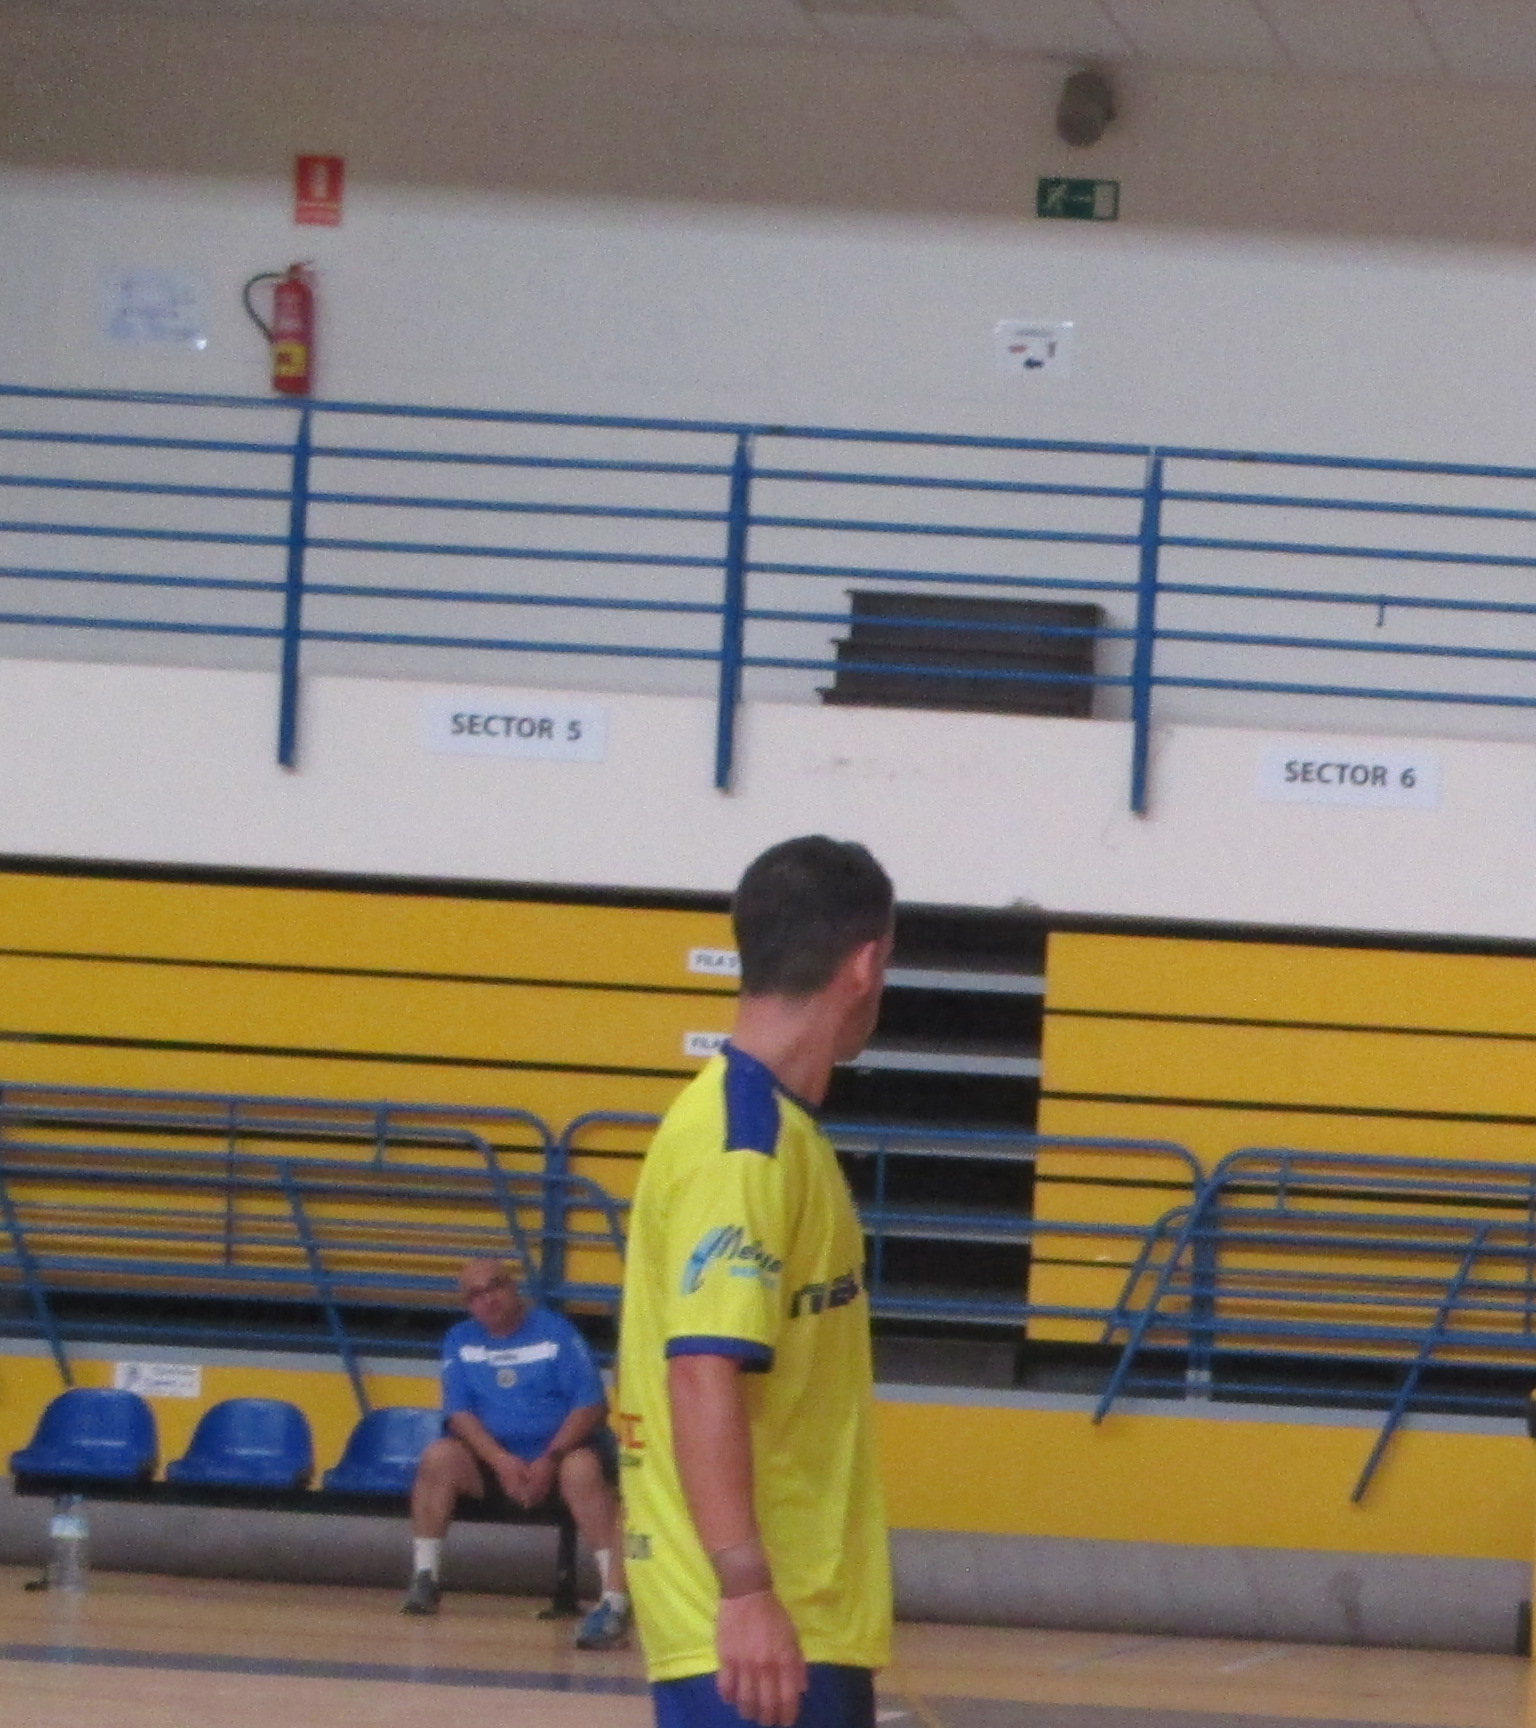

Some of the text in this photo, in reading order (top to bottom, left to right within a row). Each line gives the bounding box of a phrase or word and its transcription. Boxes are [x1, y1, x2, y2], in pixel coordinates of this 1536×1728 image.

[451, 712, 582, 741] SECTOR 5
[1284, 760, 1416, 788] SECTOR 6
